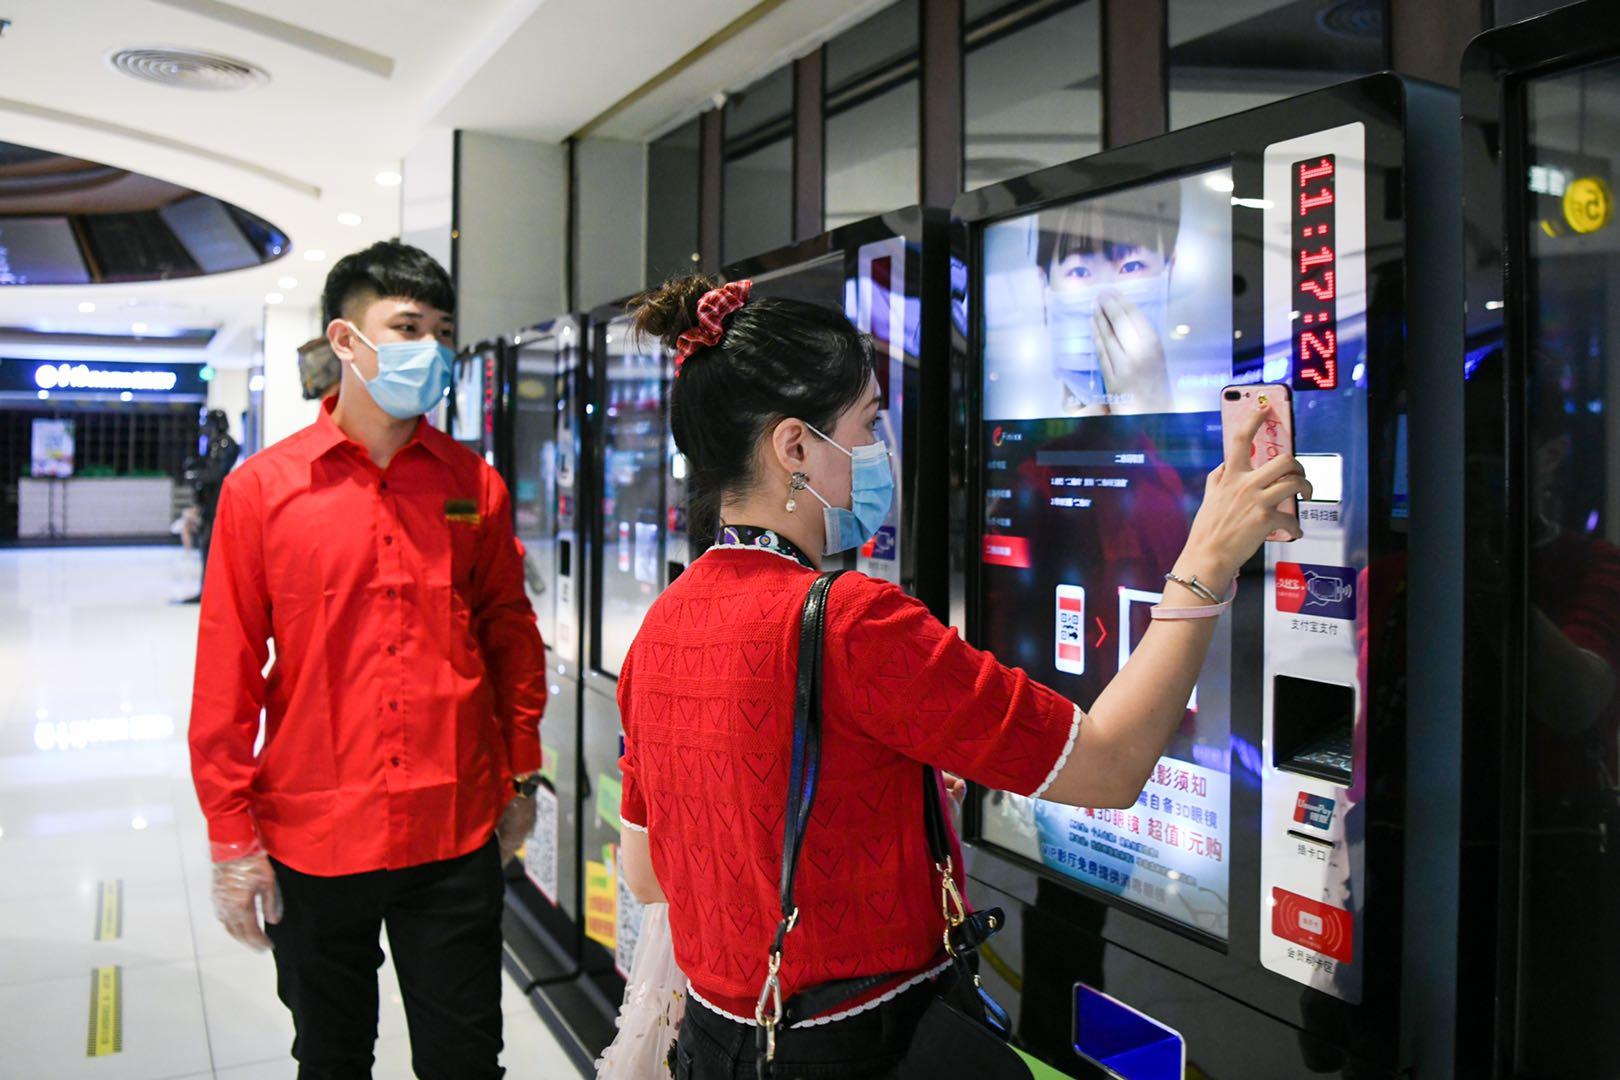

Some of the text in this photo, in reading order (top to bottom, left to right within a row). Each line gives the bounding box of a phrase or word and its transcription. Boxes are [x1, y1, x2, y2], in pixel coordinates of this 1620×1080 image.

[1300, 158, 1335, 388] 11:17:27
[1291, 619, 1339, 636] 支付宝支付
[1150, 764, 1207, 798] 影须知
[1147, 817, 1223, 862] 超值1元购
